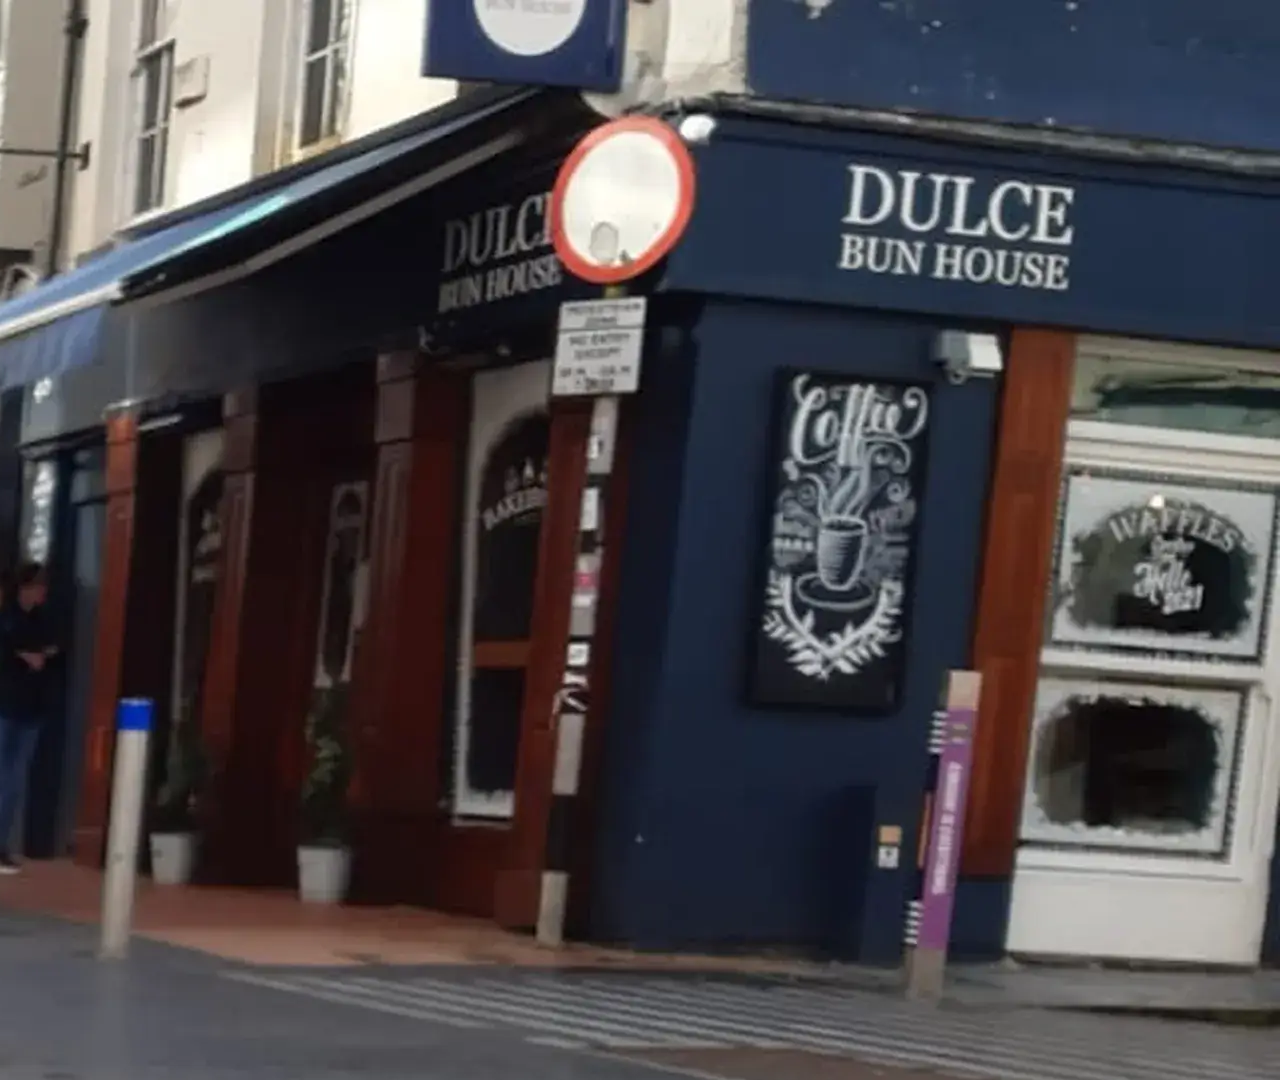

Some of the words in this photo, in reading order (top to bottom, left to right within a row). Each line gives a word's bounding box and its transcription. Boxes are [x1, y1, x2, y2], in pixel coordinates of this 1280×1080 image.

[841, 163, 1075, 245] DULCE
[439, 268, 481, 313] BUN
[486, 254, 563, 302] HOUSE
[838, 233, 927, 275] BUN
[931, 242, 1070, 291] HOUSE
[791, 374, 929, 465] Coffee
[1109, 508, 1240, 552] WAFFLES
